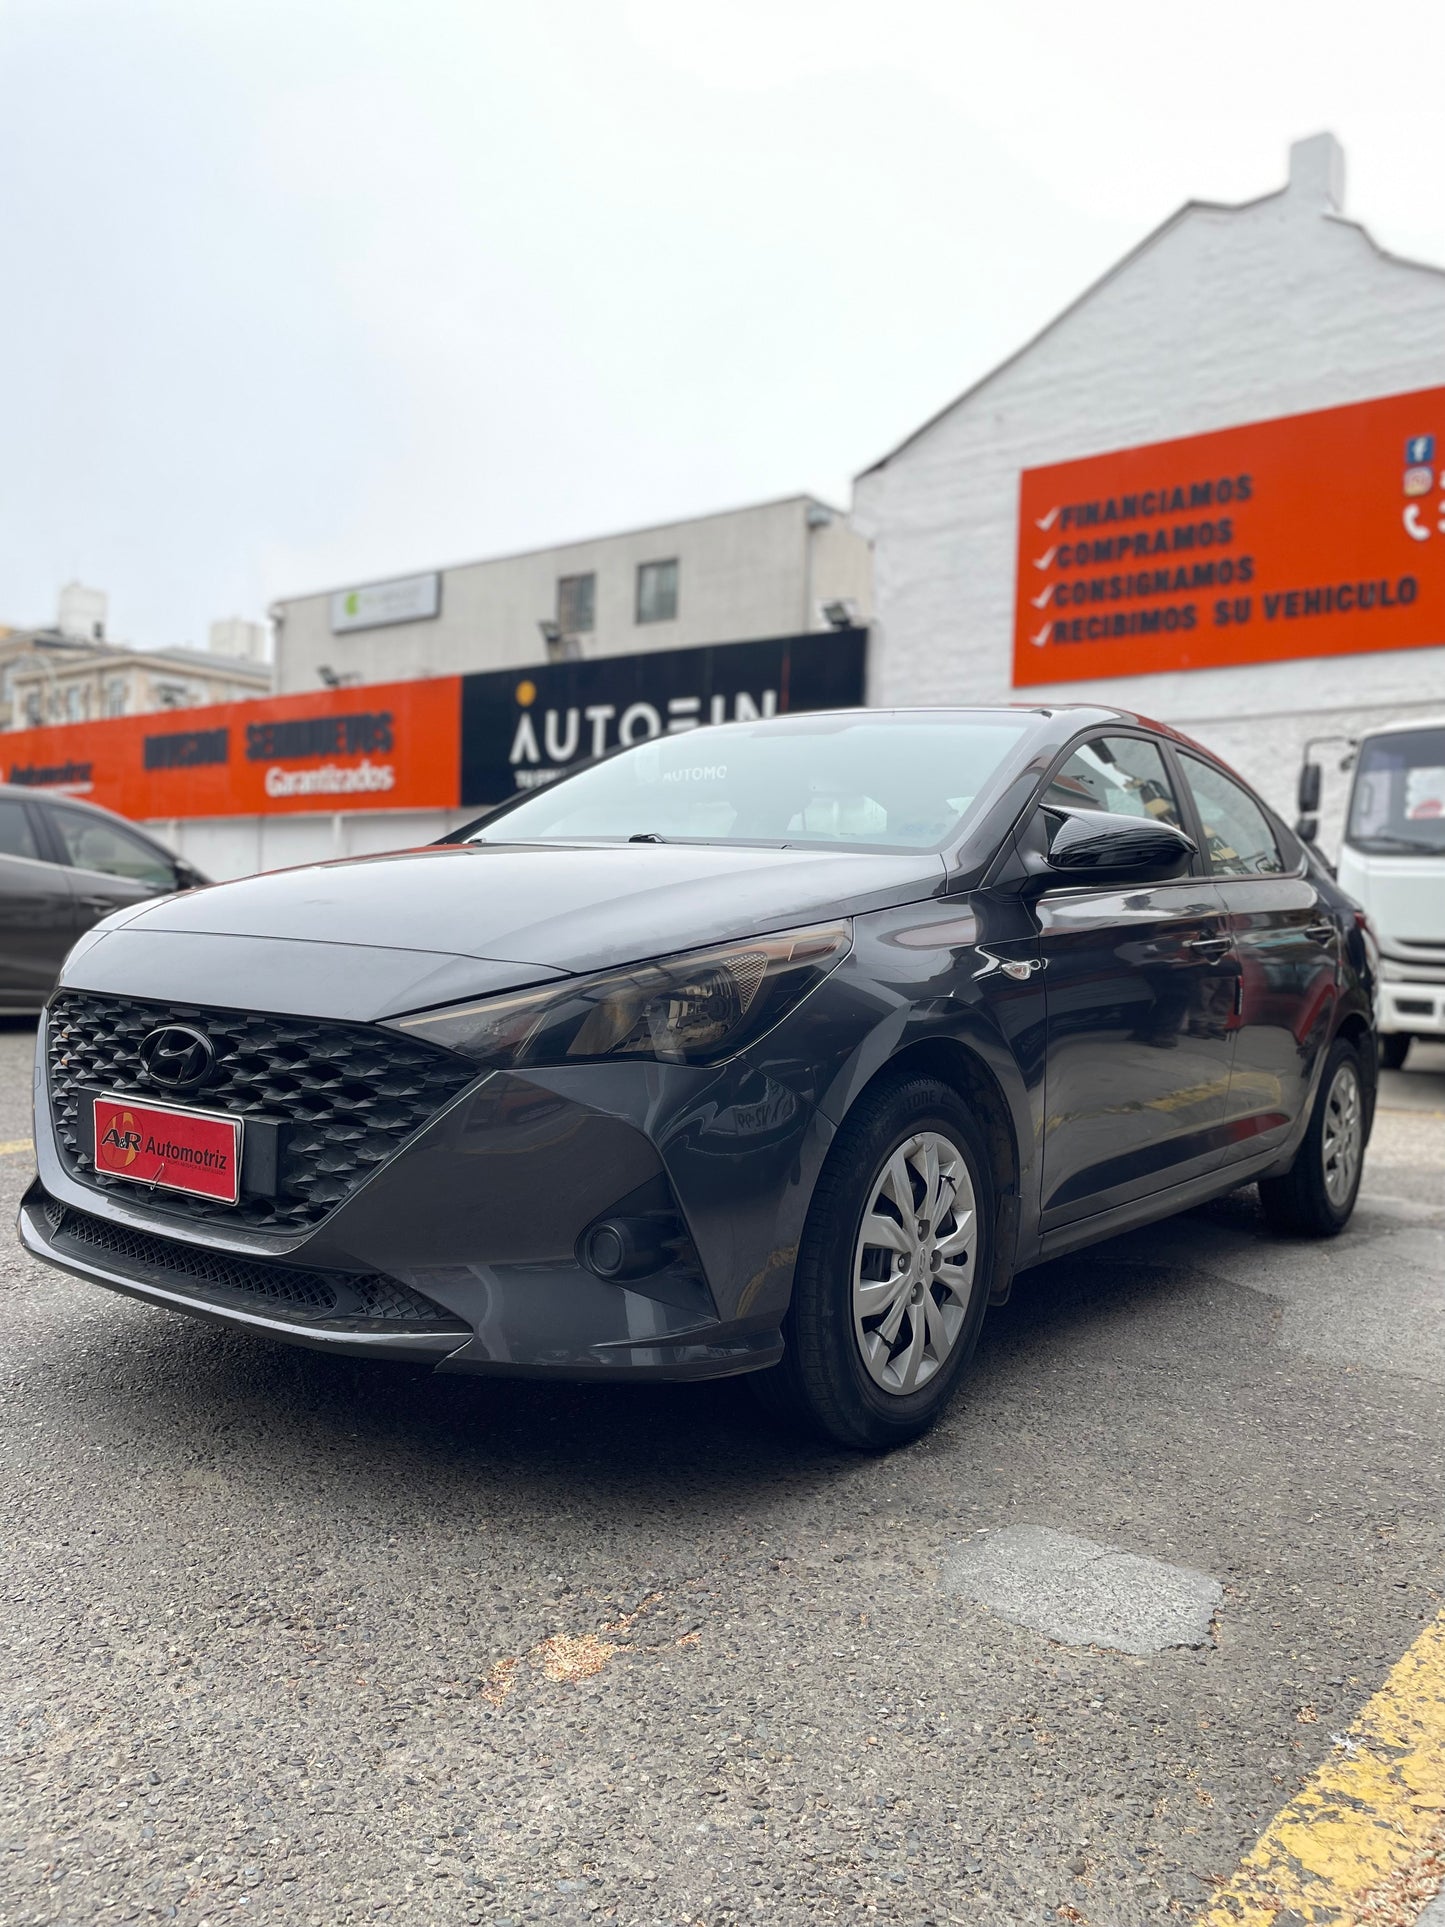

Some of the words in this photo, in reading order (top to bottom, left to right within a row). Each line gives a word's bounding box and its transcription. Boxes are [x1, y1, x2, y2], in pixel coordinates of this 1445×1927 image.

[1060, 474, 1253, 531] FINANCIAMOS
[1057, 518, 1234, 569] COMPRAMOS
[1054, 556, 1255, 607] CONSIGNAMOS
[1052, 604, 1197, 644] RECIBIMOS
[1213, 598, 1252, 625] SU
[1263, 576, 1419, 621] VEHICULO
[265, 758, 396, 799] Garantizados
[101, 1128, 142, 1152] A&R
[145, 1136, 227, 1170] Automotriz
